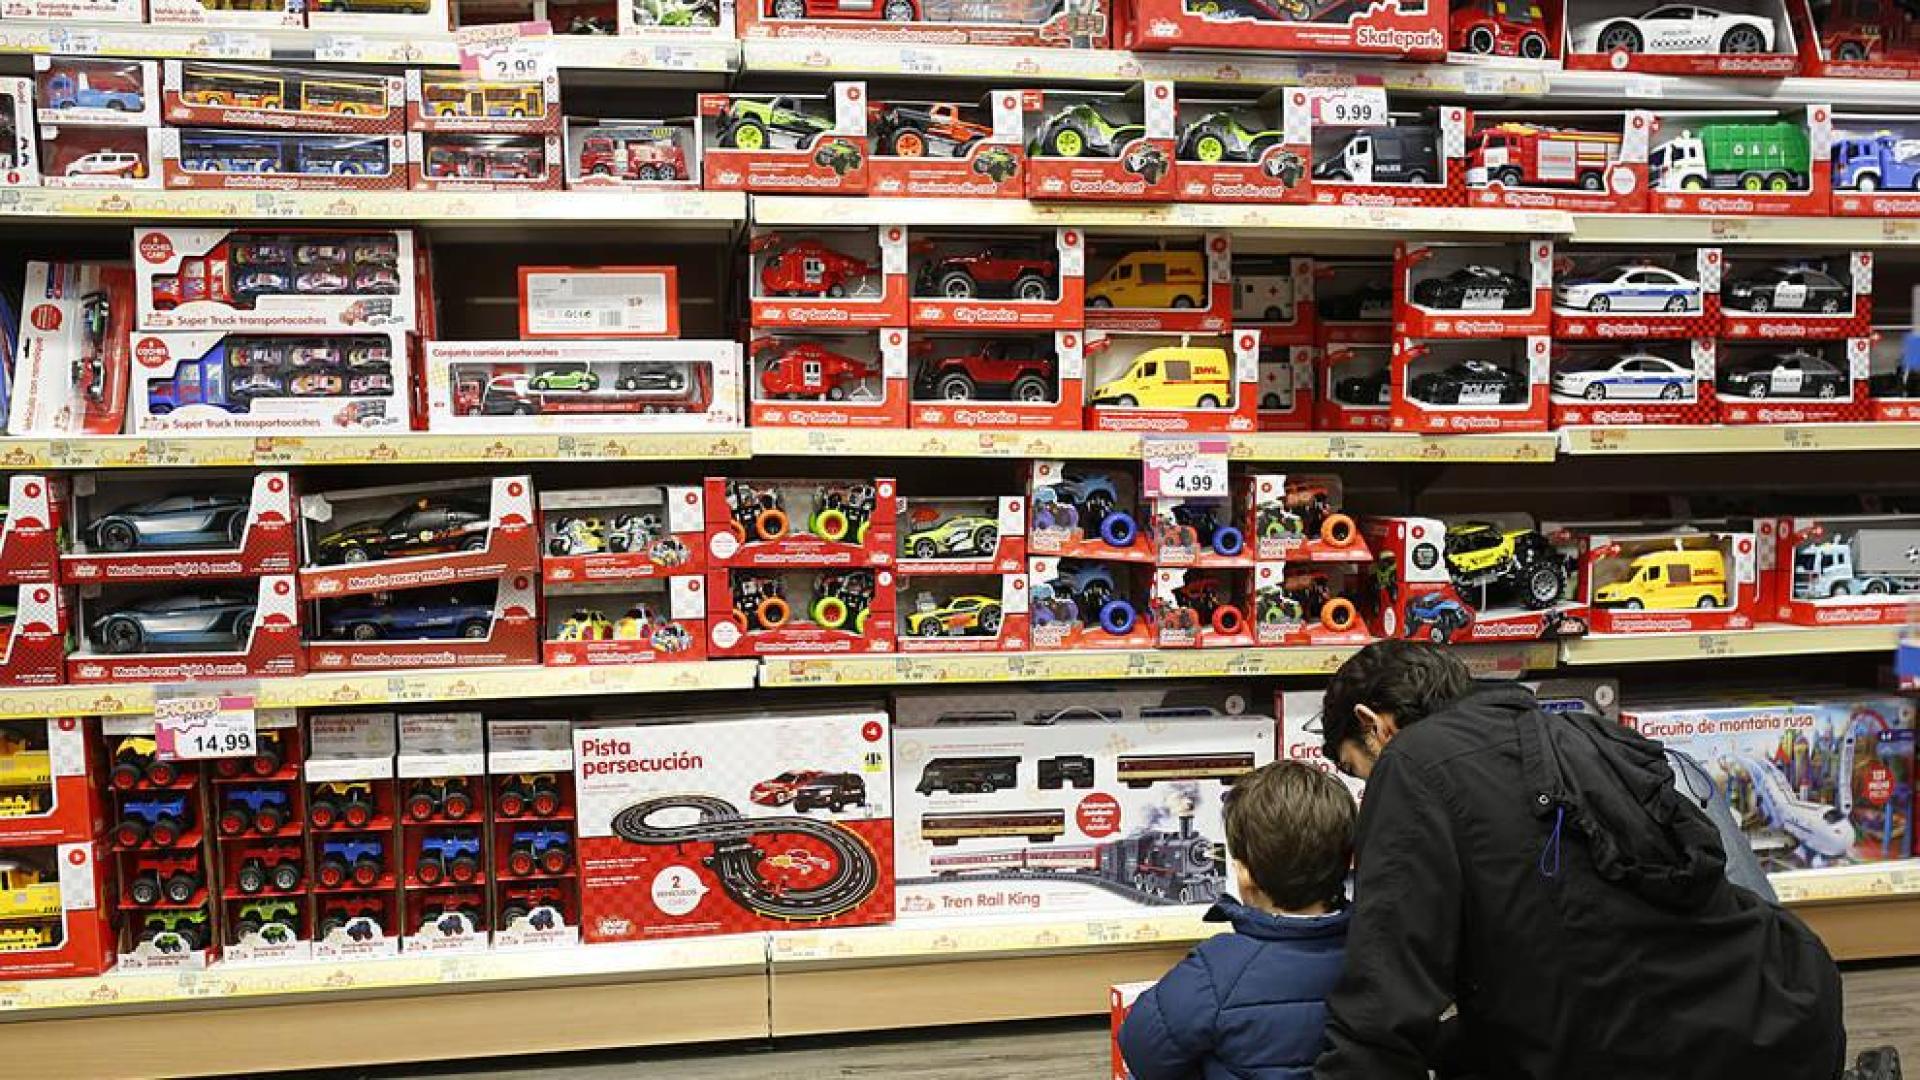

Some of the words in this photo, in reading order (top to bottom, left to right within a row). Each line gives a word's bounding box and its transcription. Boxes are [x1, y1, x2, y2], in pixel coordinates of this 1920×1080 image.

[1358, 28, 1442, 51] Skatepark
[1335, 104, 1372, 121] 9,99
[1375, 164, 1401, 172] POLICE
[1071, 180, 1102, 192] Quad
[1213, 185, 1243, 196] Quad
[141, 244, 171, 252] COCHES
[1465, 288, 1508, 298] POLICE
[177, 315, 207, 327] Super
[209, 315, 237, 325] Truck
[955, 308, 976, 323] City
[978, 308, 1018, 321] Service
[137, 348, 167, 356] COCHES
[432, 348, 471, 359] Conjunto
[1462, 383, 1506, 394] POLICE
[172, 419, 202, 430] Super
[204, 419, 231, 428] Truck
[955, 410, 976, 425] City
[978, 410, 1017, 423] Service
[1174, 474, 1213, 492] 4,99
[1641, 720, 1694, 738] Circuito
[1697, 719, 1716, 734] de
[1719, 716, 1780, 732] montaña
[1783, 714, 1815, 729] rusa
[193, 732, 251, 755] 14,99
[582, 738, 631, 757] Pista
[1290, 742, 1322, 759] Circ
[582, 752, 704, 780] persecución
[670, 875, 681, 889] 2
[941, 895, 973, 909] Tren
[976, 892, 1005, 907] Rail
[1007, 891, 1041, 909] King
